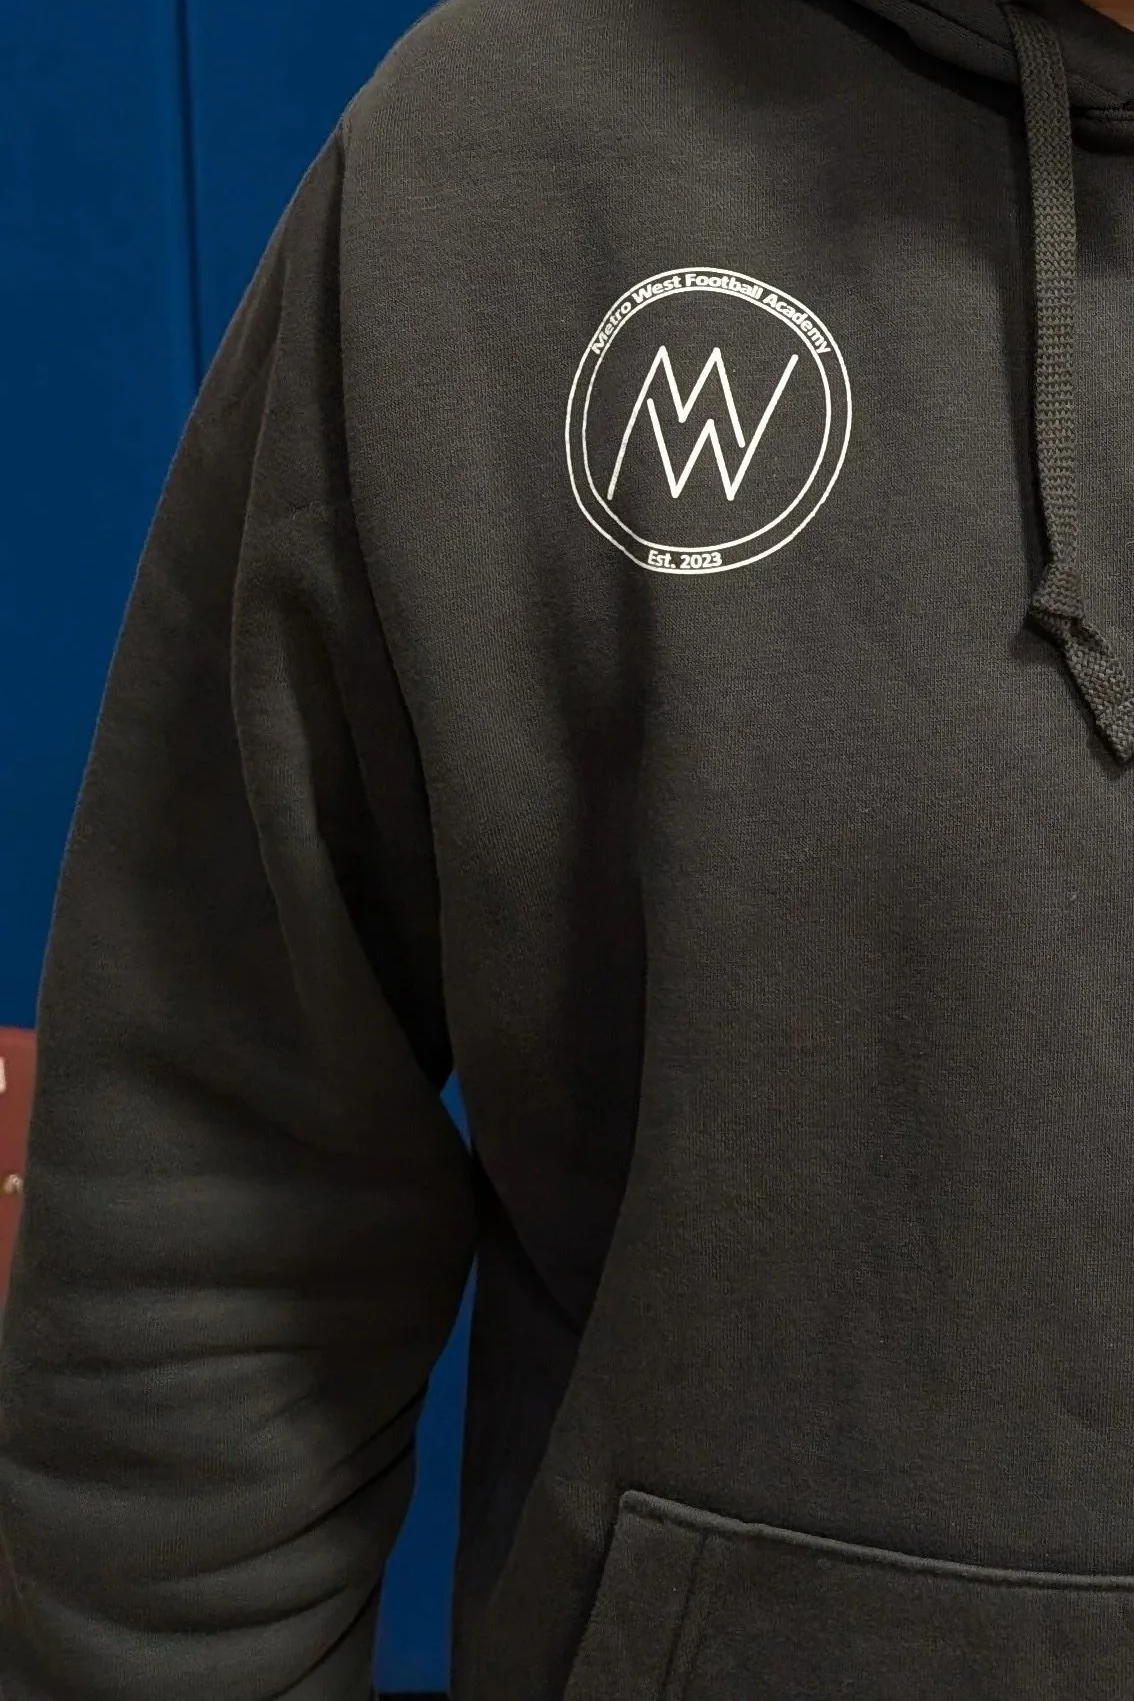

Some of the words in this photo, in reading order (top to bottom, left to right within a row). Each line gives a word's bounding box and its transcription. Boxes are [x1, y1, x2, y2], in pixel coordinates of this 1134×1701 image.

[591, 302, 632, 355] Metro
[631, 275, 682, 304] West
[685, 273, 764, 300] Football
[762, 293, 831, 354] Academy
[647, 549, 677, 569] Est.
[679, 551, 723, 569] 2023
